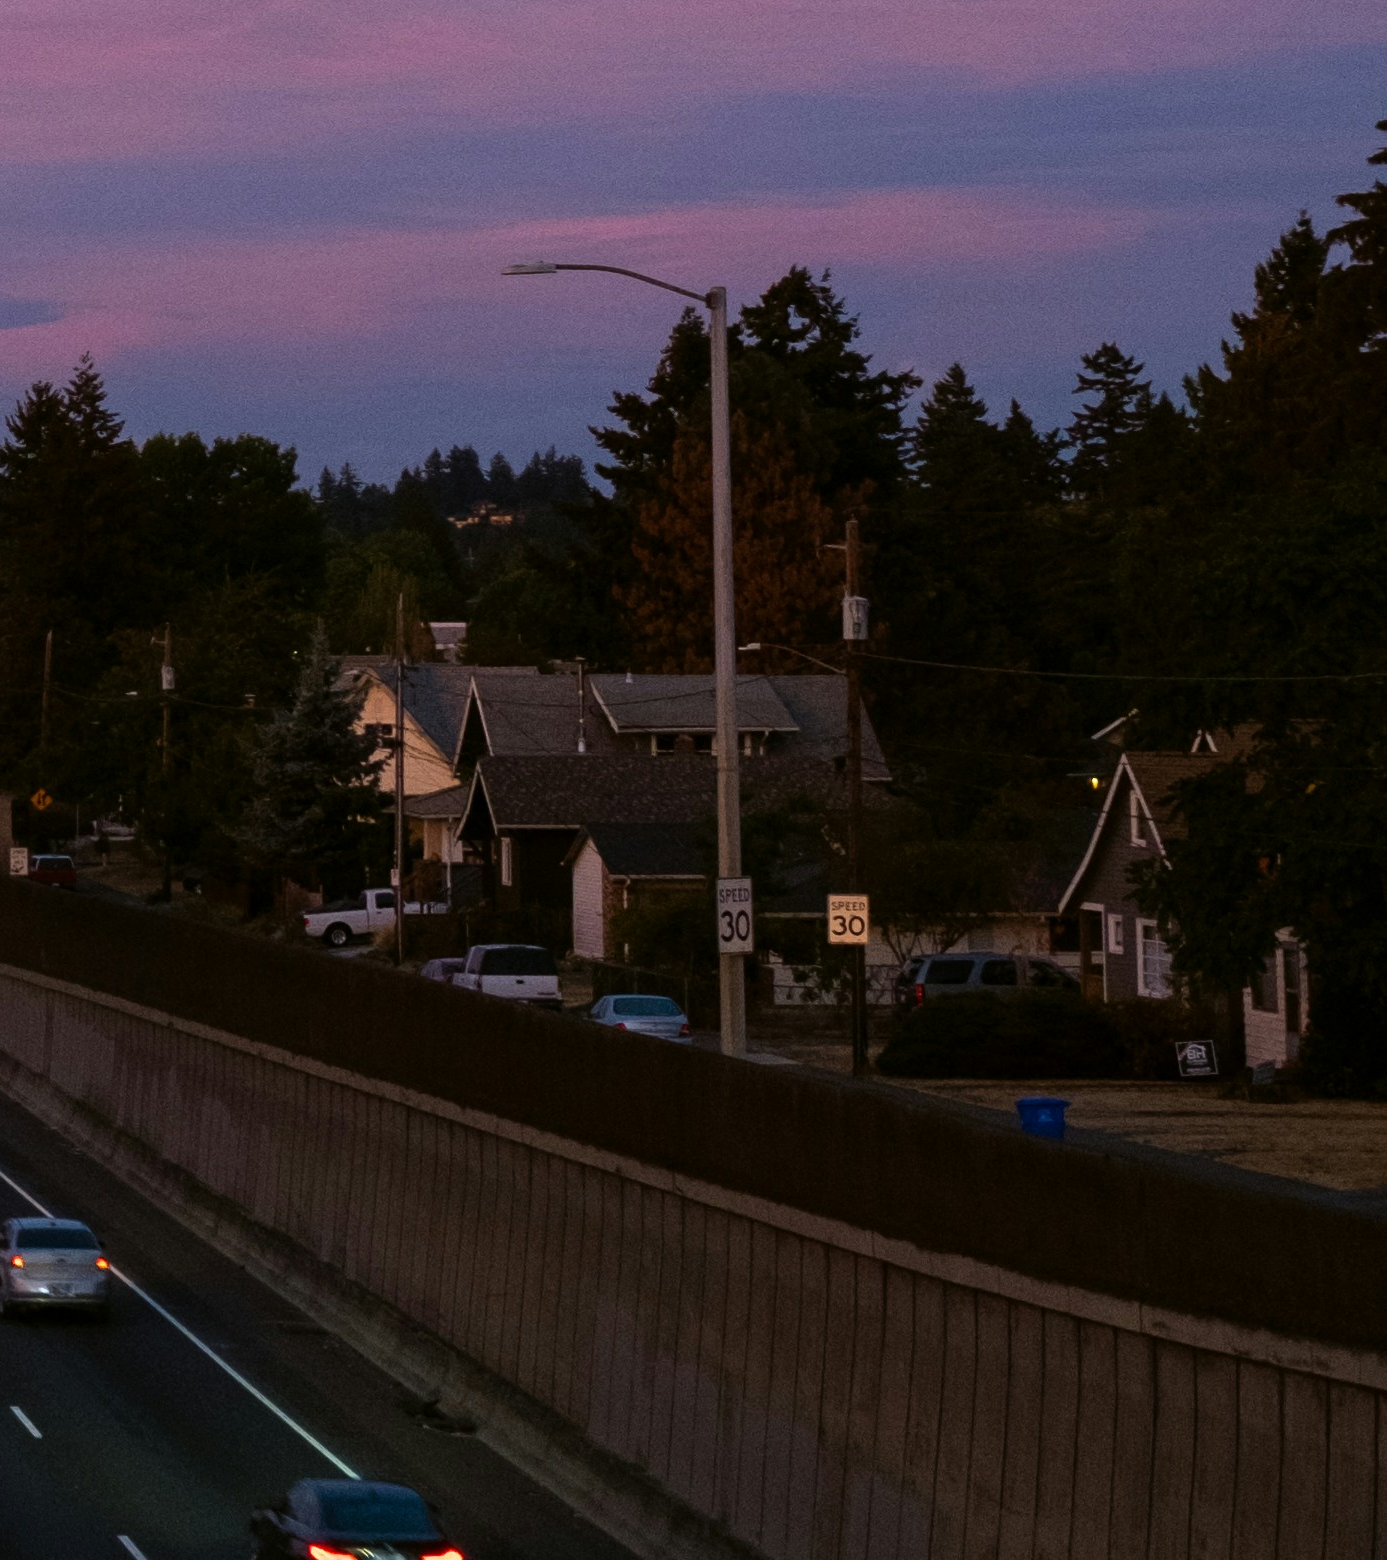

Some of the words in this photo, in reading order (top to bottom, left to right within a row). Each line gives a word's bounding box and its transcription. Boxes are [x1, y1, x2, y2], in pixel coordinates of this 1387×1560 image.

[719, 888, 749, 902] SPEED
[831, 901, 865, 911] SPEED
[721, 910, 750, 942] 30
[832, 915, 865, 936] 30
